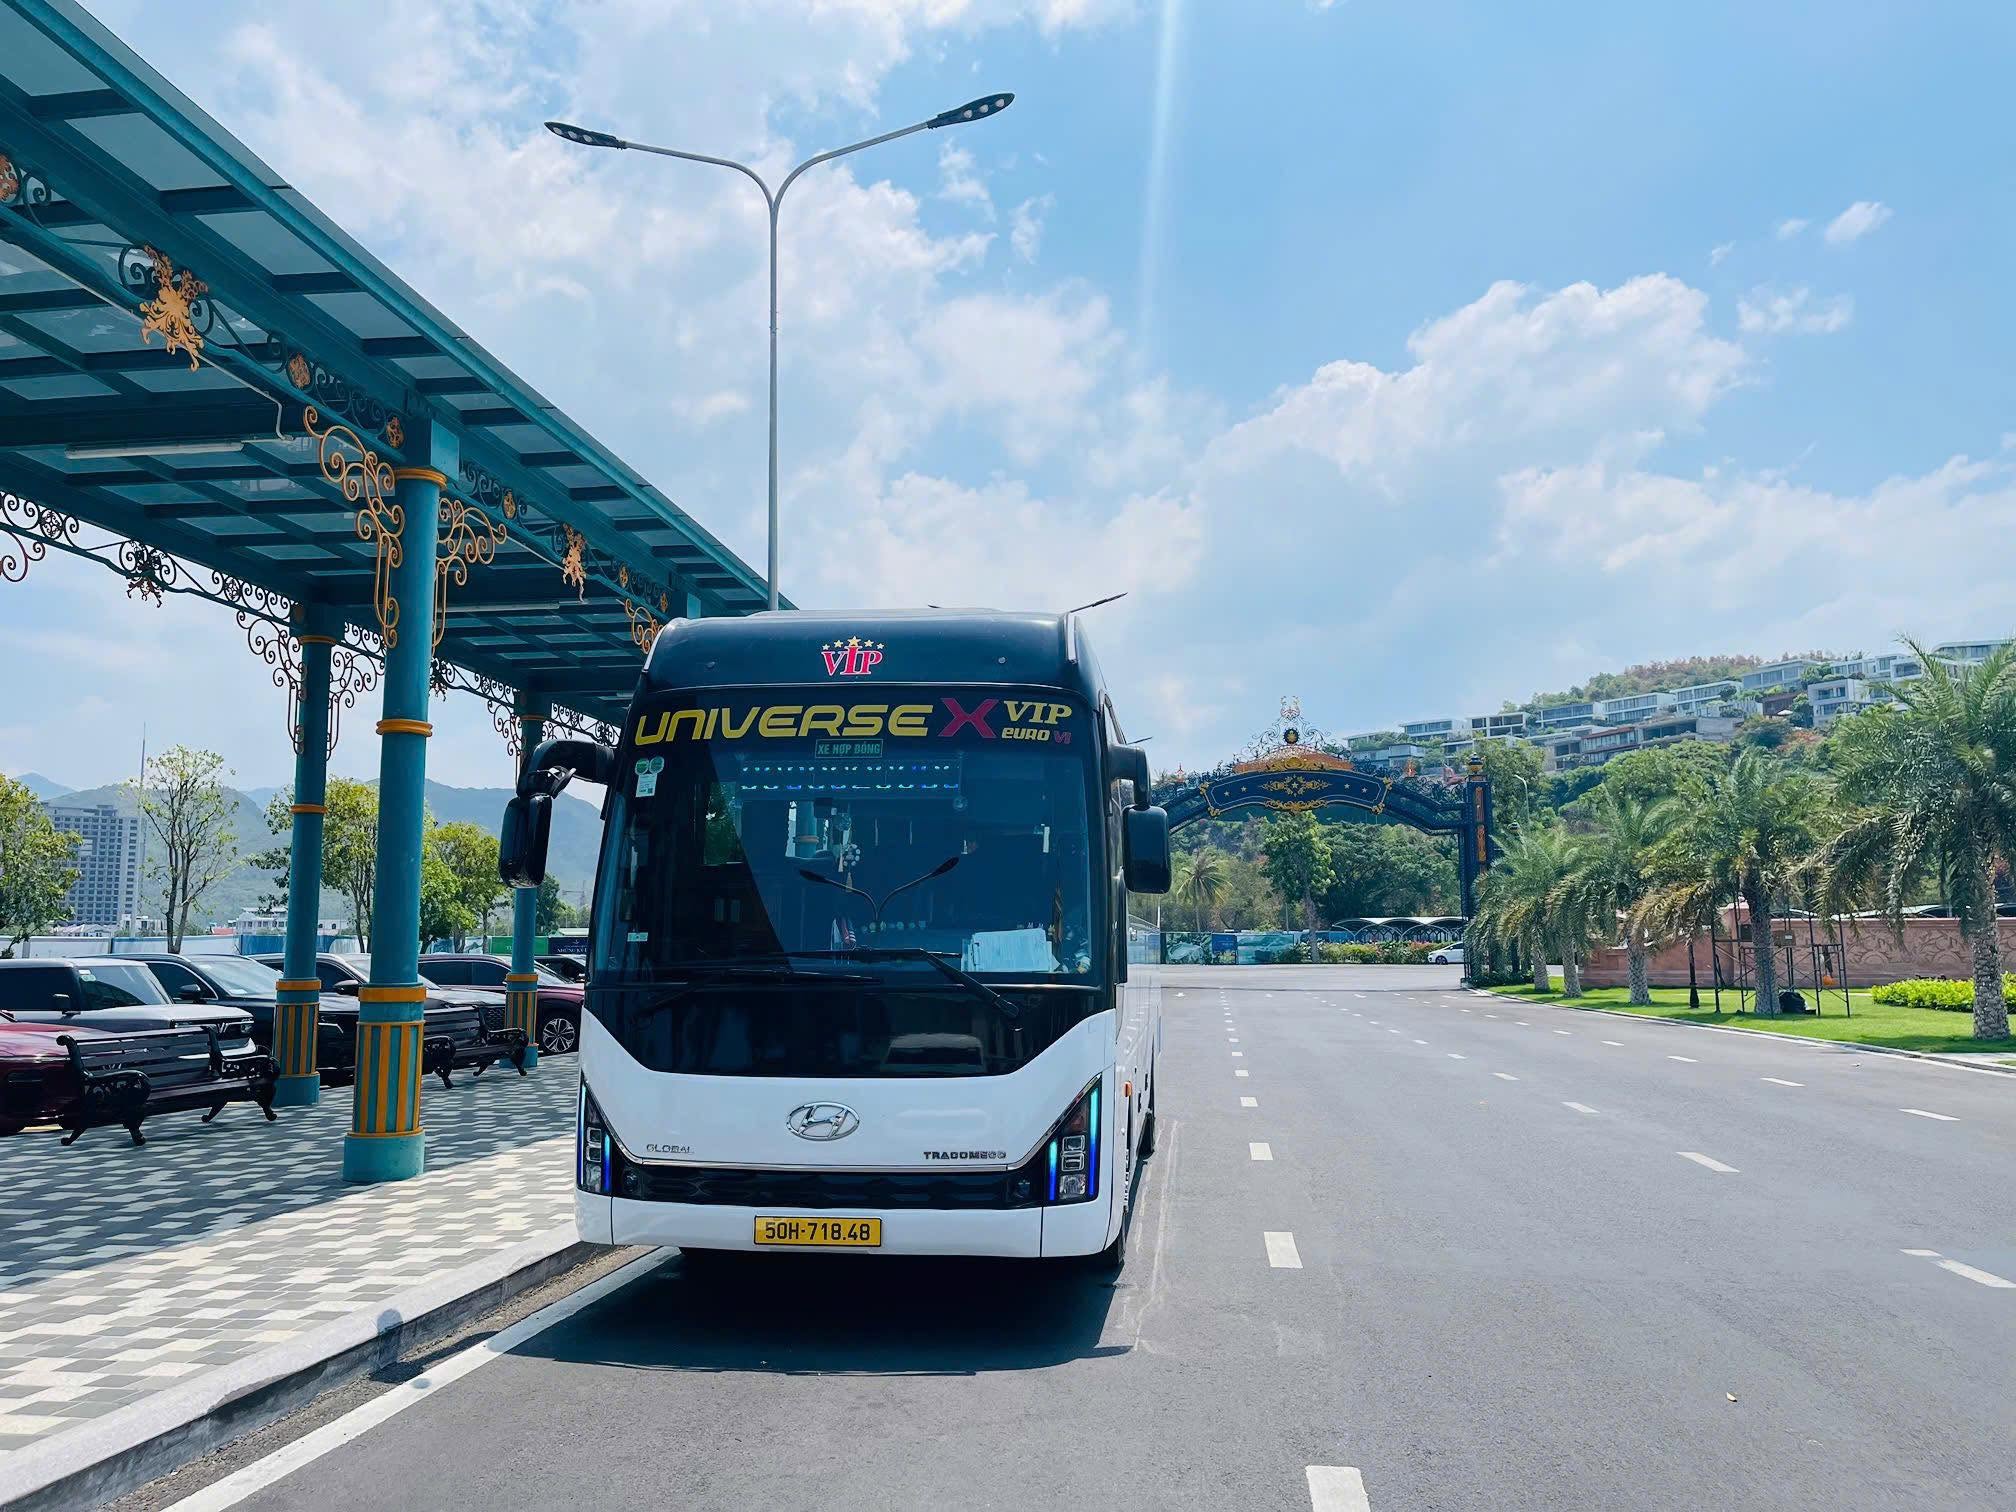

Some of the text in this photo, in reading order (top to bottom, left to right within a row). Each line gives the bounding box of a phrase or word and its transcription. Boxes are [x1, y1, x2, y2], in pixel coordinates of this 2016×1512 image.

[821, 645, 883, 676] VIP
[635, 698, 1073, 746] UNIVERSE X VIP
[817, 743, 830, 755] XE
[646, 1143, 695, 1154] GLOBAL
[765, 1221, 870, 1241] 50H-718.48
